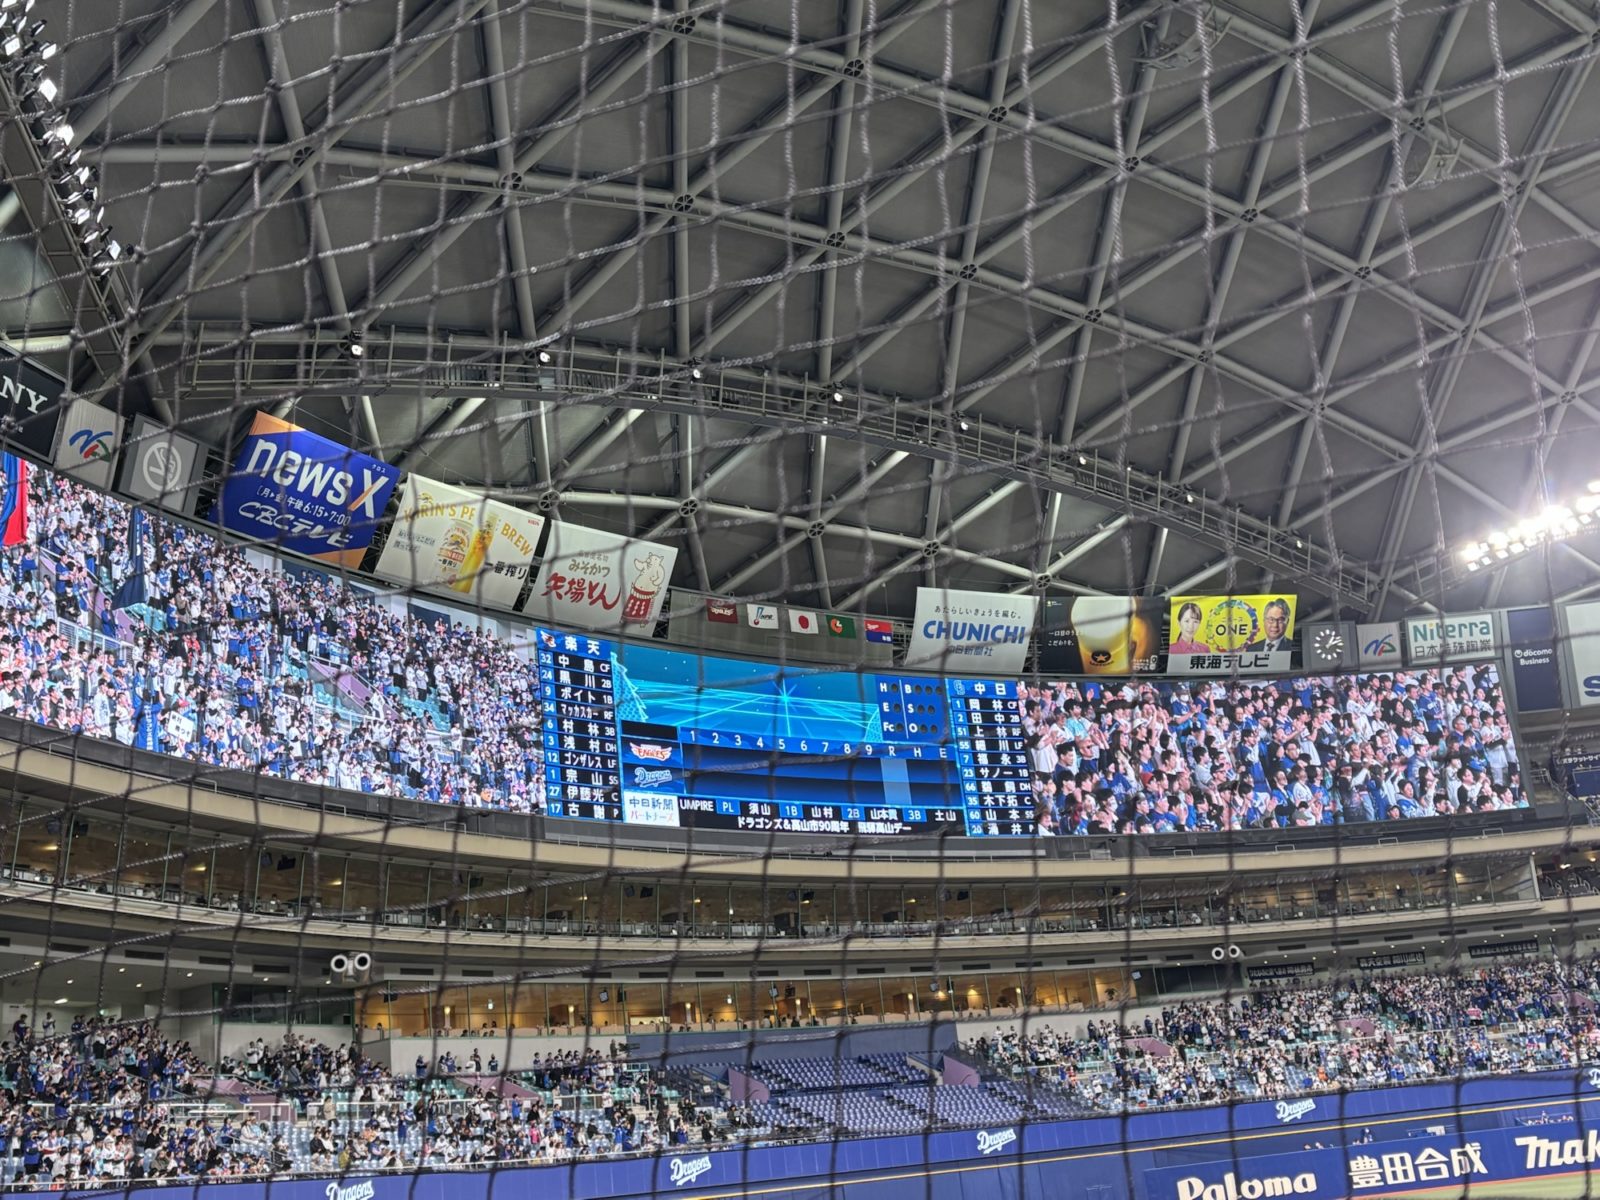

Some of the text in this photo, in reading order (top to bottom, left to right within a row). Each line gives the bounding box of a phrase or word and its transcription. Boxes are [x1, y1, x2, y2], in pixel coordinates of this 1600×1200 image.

[239, 501, 353, 548] CBCテレビ
[501, 523, 533, 557] BREW
[485, 561, 527, 580] 一番搾り
[568, 558, 611, 577] みそかつ
[541, 572, 622, 611] 矢場とん
[934, 605, 1022, 620] あたらしいきょうを編む。
[923, 620, 1026, 645] CHUNICHI
[1215, 624, 1248, 636] ONE
[1413, 620, 1491, 642] Niterra
[565, 636, 600, 655] 楽天
[1414, 639, 1492, 658] 日本特殊陶業
[540, 653, 610, 672] 32 中島 CF
[1189, 654, 1270, 669] 東海テレビ
[1519, 656, 1550, 666] Business
[542, 670, 612, 688] 24 黒川 2B
[545, 686, 551, 695] 9
[603, 695, 613, 704] 1B
[880, 683, 912, 694] H B
[974, 682, 1006, 695] 中日
[544, 703, 555, 712] 34
[604, 711, 614, 719] RF
[883, 702, 914, 713] E S
[957, 700, 961, 709] 1
[958, 714, 964, 722] 2
[972, 713, 1005, 724] 田中
[547, 719, 615, 737] 6 村林 3B
[883, 722, 894, 732] Fc
[958, 726, 1021, 738] 51 上林 RF
[548, 736, 554, 745] 3
[605, 743, 617, 752] DH
[690, 731, 947, 758] 1 2 3 4 5 6 7 8 9 R H E
[960, 741, 970, 749] 55
[547, 752, 617, 768] 12 ゴンザレス LF
[963, 755, 969, 763] 7
[551, 770, 556, 779] 1
[608, 776, 618, 784] SS
[634, 767, 672, 787] Dragons
[963, 767, 1029, 778] 23 サノー 1B
[549, 787, 560, 795] 27
[611, 793, 619, 801] C
[965, 783, 976, 791] 66
[1020, 783, 1031, 791] DH
[629, 798, 673, 810] 中日新聞
[967, 797, 978, 805] 35
[983, 795, 1018, 807] 木下拓
[551, 804, 561, 813] 17
[613, 809, 619, 817] P
[630, 810, 673, 822] パートナーズ
[679, 799, 956, 821] UMPIRE PL 須山 1B 山村 2B 山本貴 3B 土山
[969, 809, 1034, 820] 60 山本 SS
[972, 825, 982, 833] 20
[1276, 1099, 1315, 1123] Dragons
[977, 1128, 1016, 1154] Dragons
[670, 1151, 711, 1186] Dragons
[1348, 1142, 1488, 1188] 豊田合成
[326, 1181, 375, 1200] Dragons
[1177, 1171, 1318, 1200] Paloma
